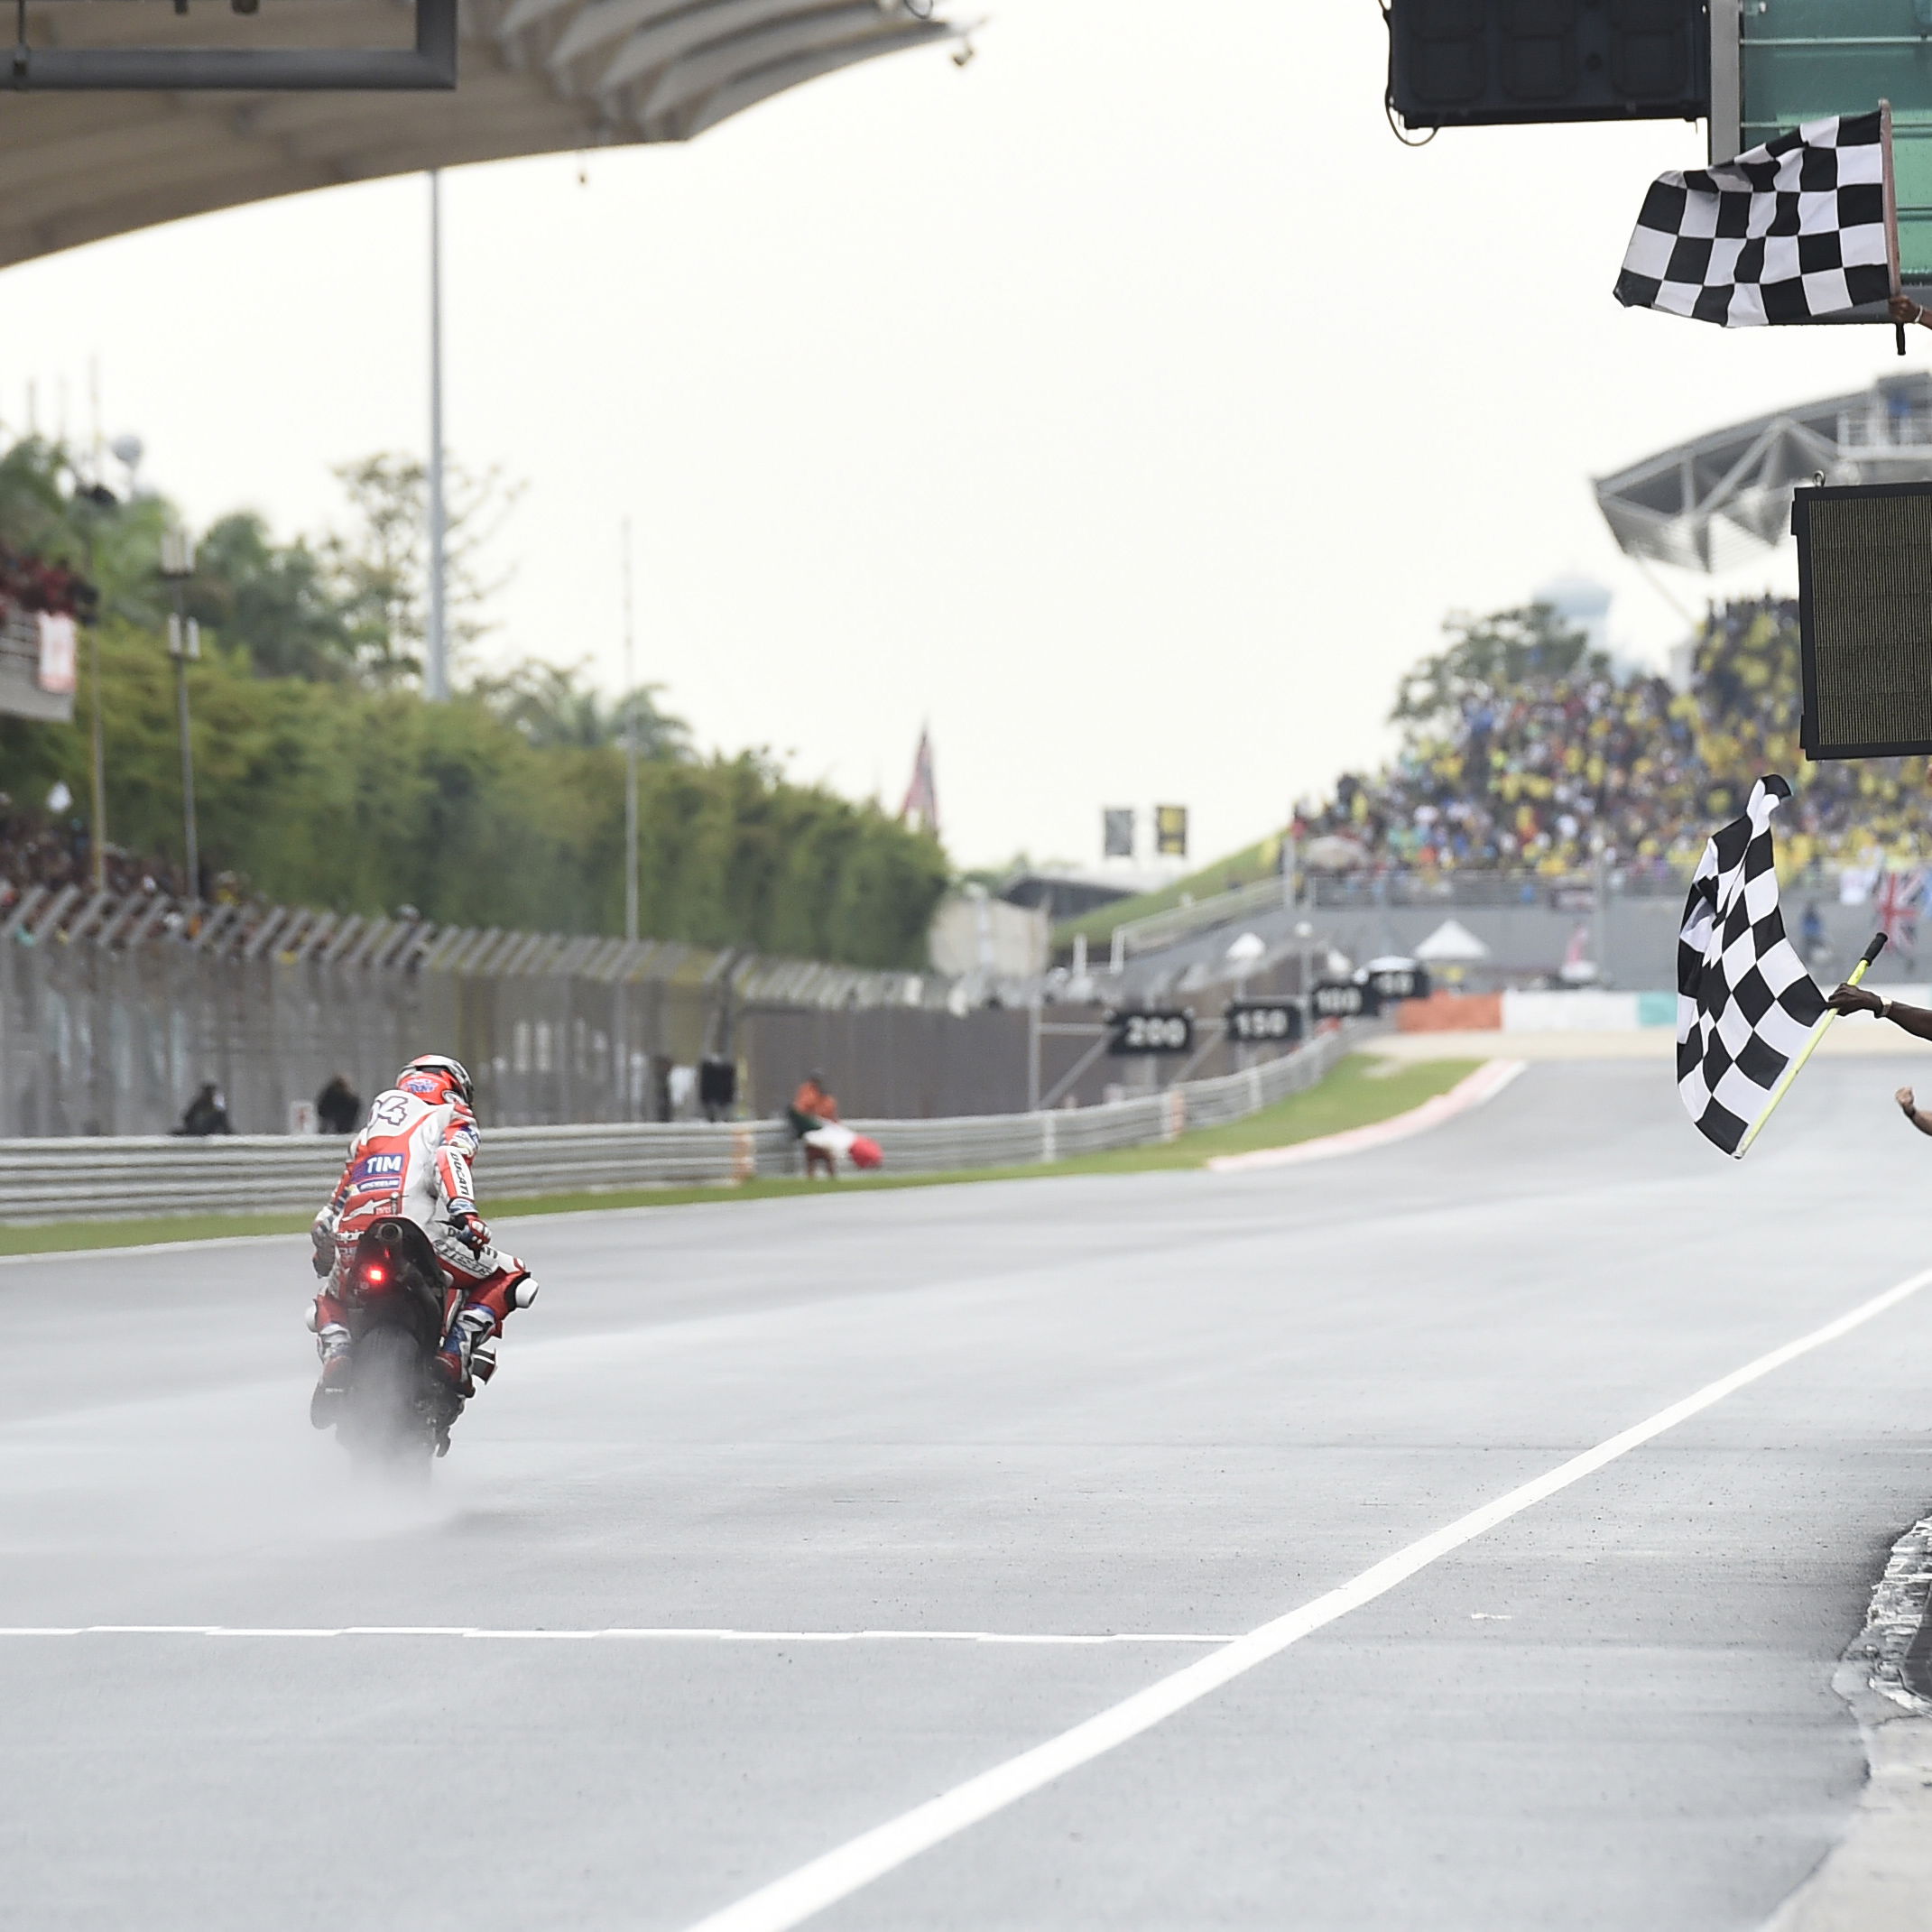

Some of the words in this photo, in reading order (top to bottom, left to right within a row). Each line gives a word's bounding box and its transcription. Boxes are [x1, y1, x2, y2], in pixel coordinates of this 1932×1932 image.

[1127, 1015, 1186, 1047] 200
[366, 1155, 402, 1174] TIM
[450, 1151, 470, 1197] DUCATI
